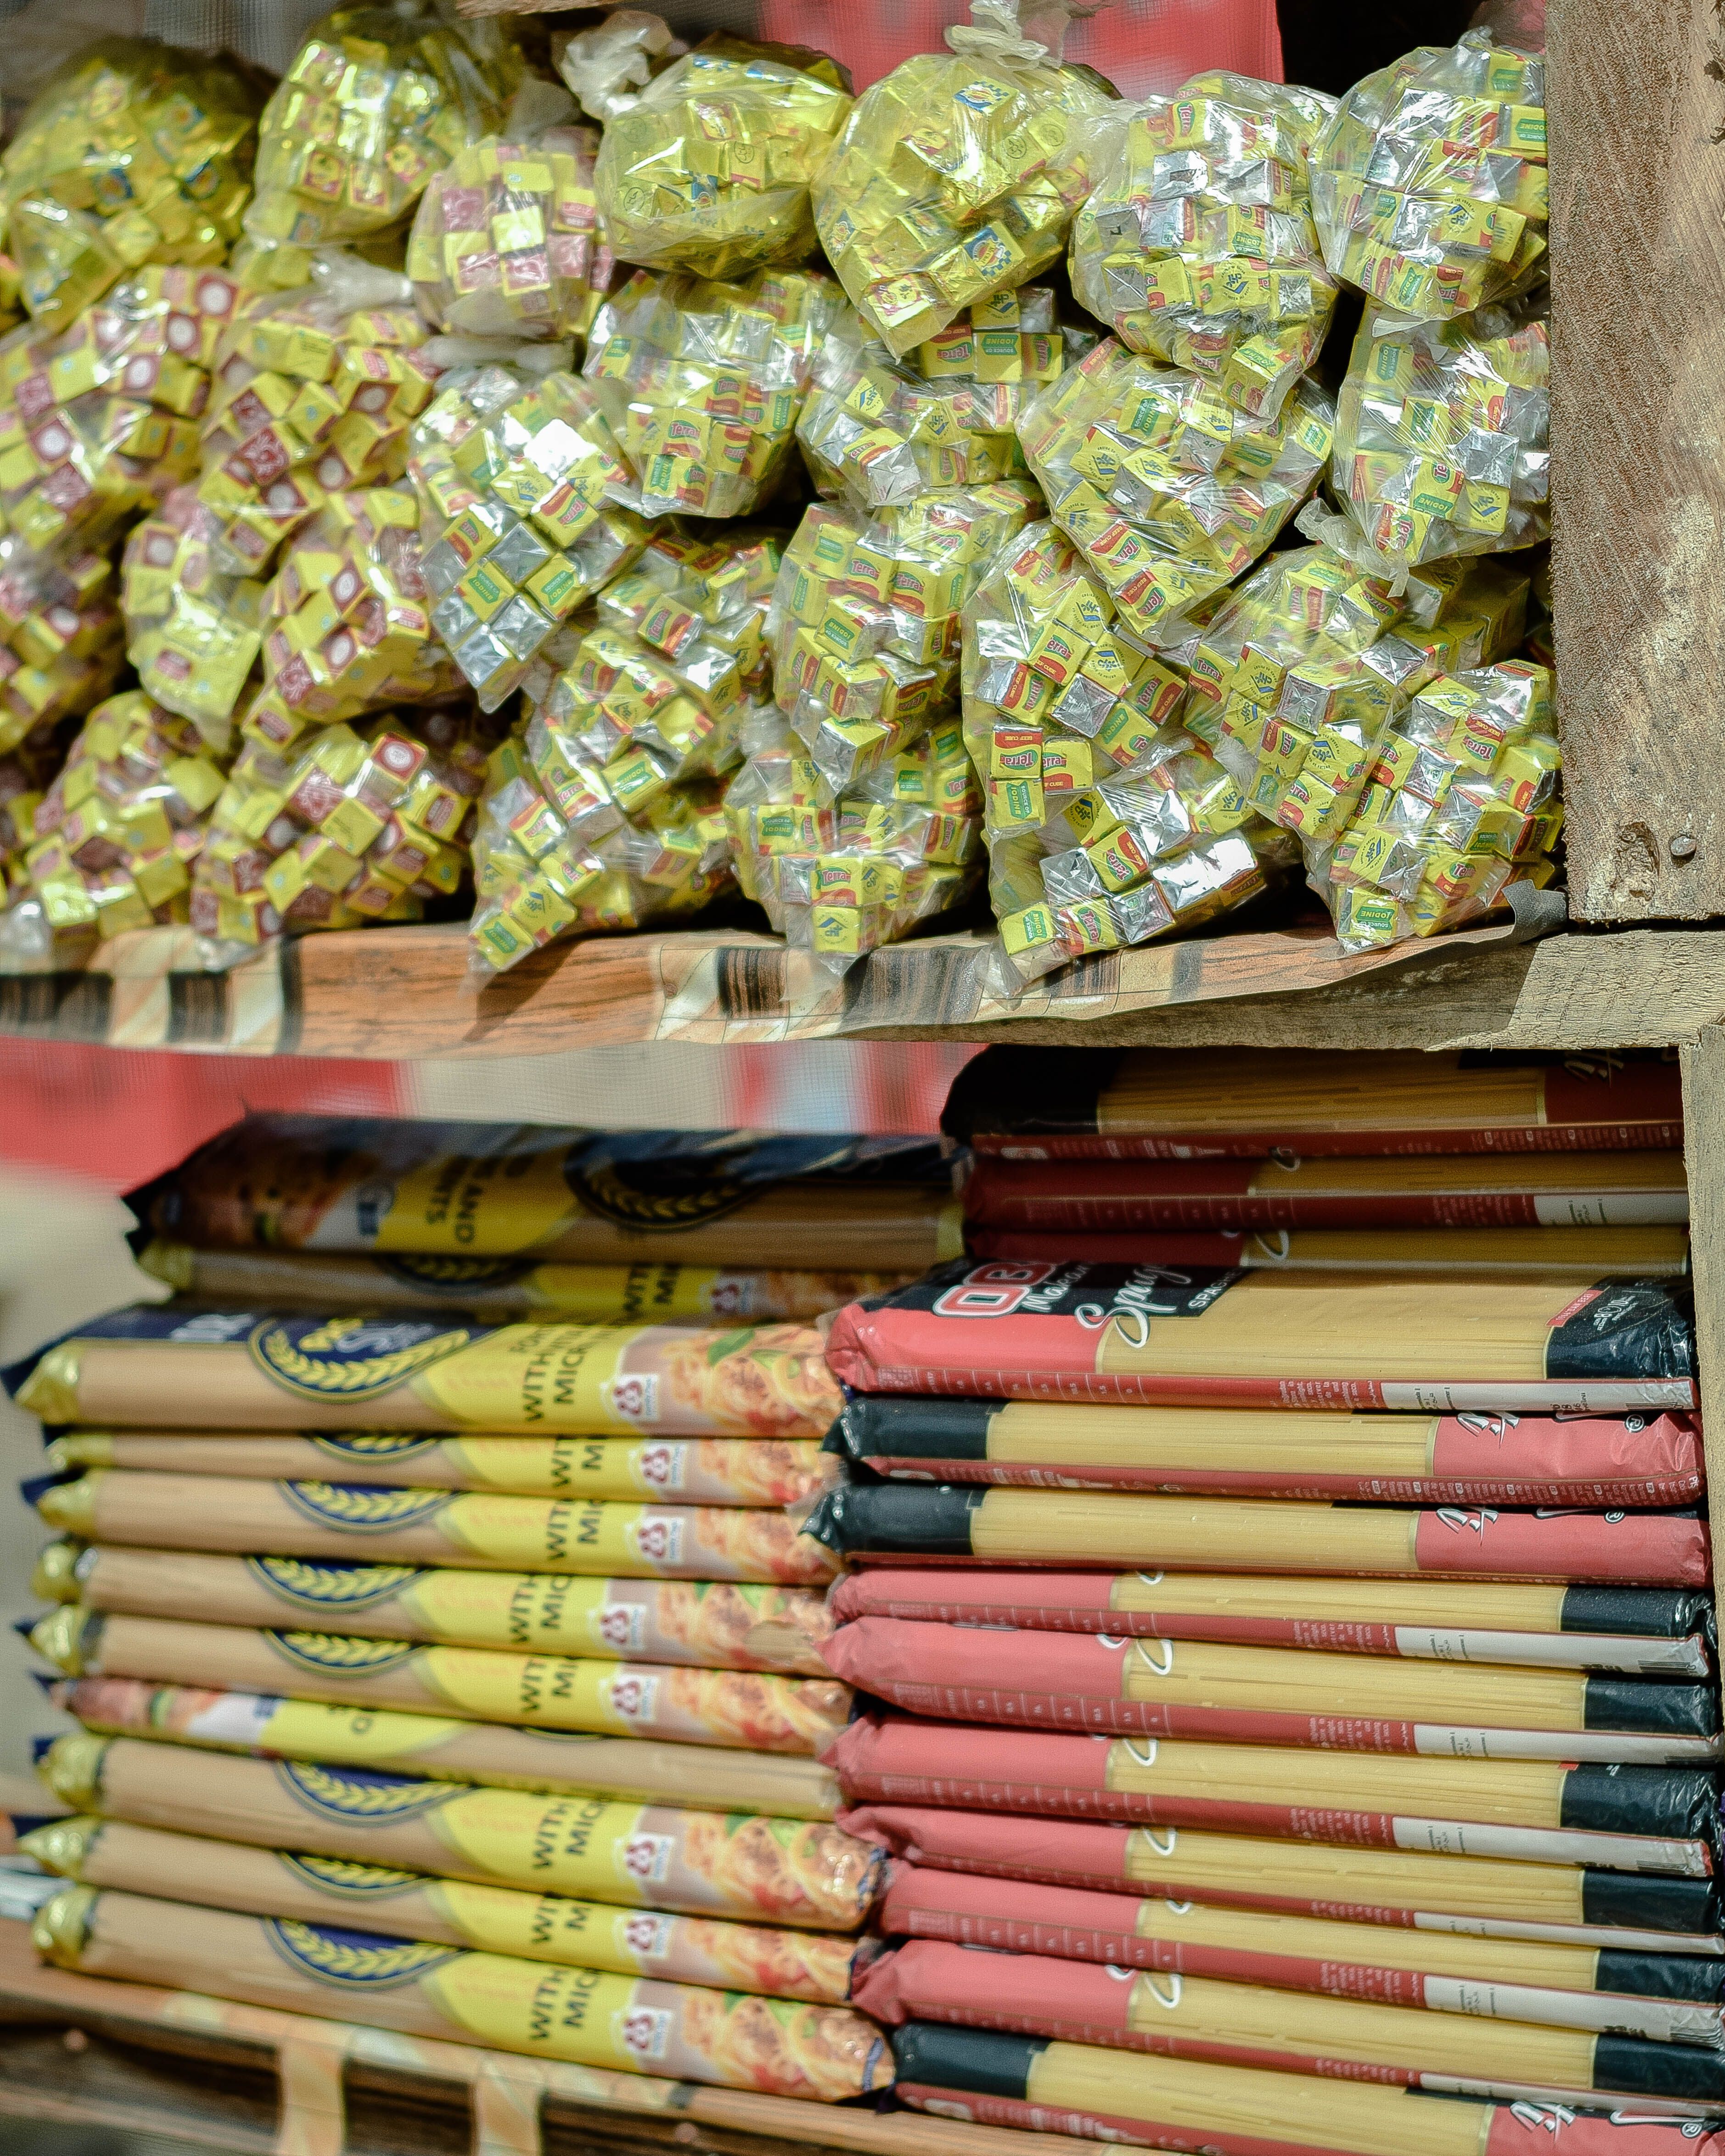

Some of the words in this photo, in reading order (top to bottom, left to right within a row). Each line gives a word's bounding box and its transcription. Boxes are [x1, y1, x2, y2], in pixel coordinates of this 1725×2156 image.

[938, 347, 969, 359] Terra
[1135, 407, 1146, 427] SOURCE
[852, 559, 879, 580] Terra
[896, 573, 923, 593] Terra
[1044, 664, 1056, 675] CUBE
[1197, 658, 1222, 679] Terra
[1010, 684, 1018, 697] CUBE
[1137, 677, 1160, 706] Terra
[1202, 686, 1215, 696] CUBE
[1165, 695, 1176, 707] CUBE
[1282, 732, 1293, 754] erra
[1463, 735, 1494, 759] Terra
[1003, 750, 1034, 765] Terra
[1043, 755, 1066, 766] erra
[1312, 747, 1331, 763] chi
[1011, 786, 1020, 816] IODINE
[1023, 805, 1029, 814] OF
[1075, 805, 1091, 820] chi
[1107, 851, 1131, 880] Terra
[822, 870, 850, 882] Terra
[1360, 910, 1393, 919] IODINE
[1084, 912, 1100, 943] Terra
[932, 1262, 1056, 1318] OB
[521, 1661, 546, 1712] WIT
